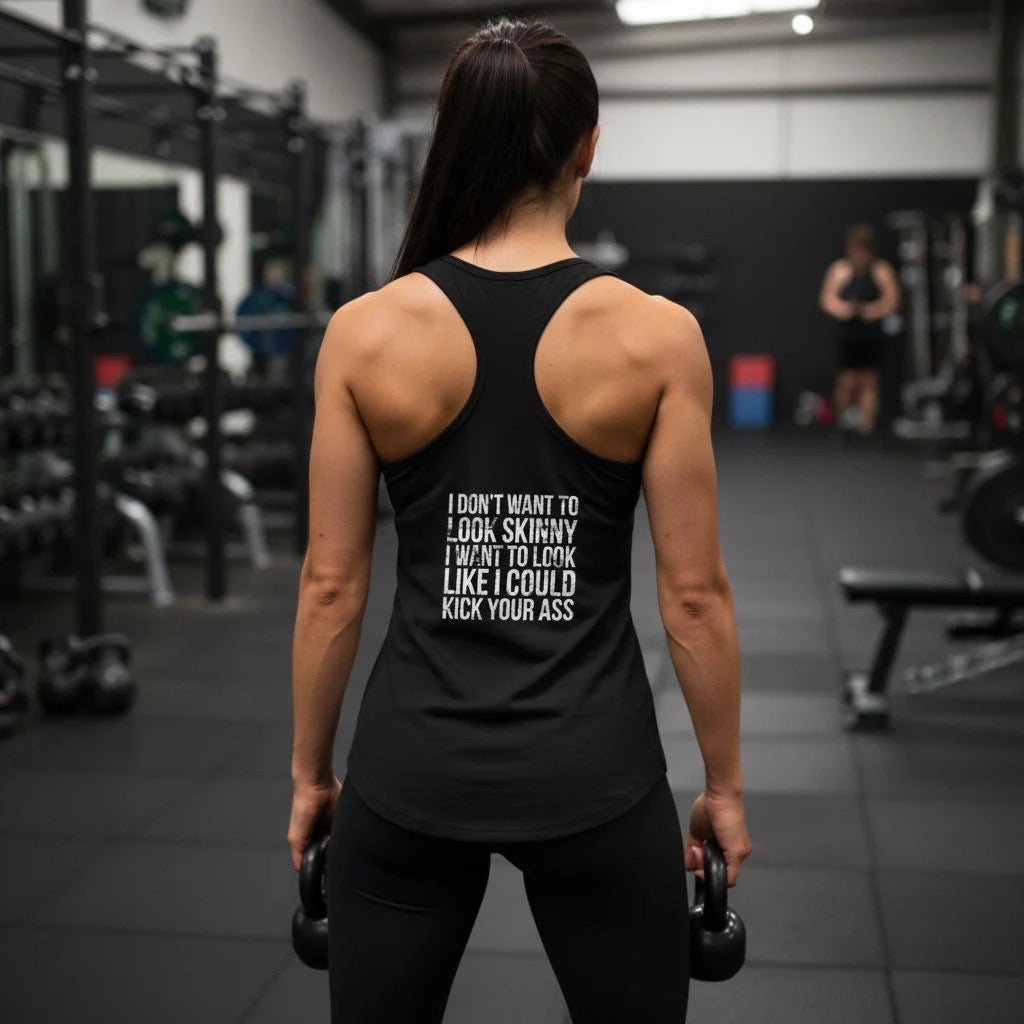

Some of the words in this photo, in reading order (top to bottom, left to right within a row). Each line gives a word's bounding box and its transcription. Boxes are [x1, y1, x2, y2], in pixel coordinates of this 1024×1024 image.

[448, 493, 453, 514] I
[457, 494, 503, 514] DON'T
[507, 494, 554, 515] WANT
[559, 495, 579, 516] TO
[447, 517, 498, 542] LOOK
[502, 517, 577, 544] SKINNY
[445, 545, 450, 565] I
[455, 545, 503, 566] WANT
[507, 546, 528, 567] TO
[533, 546, 576, 568] LOOK
[444, 568, 489, 595] LIKE
[494, 569, 500, 595] I
[506, 569, 576, 596] COULD
[442, 597, 483, 620] KICK
[488, 598, 534, 621] YOUR
[538, 598, 574, 621] ASS
